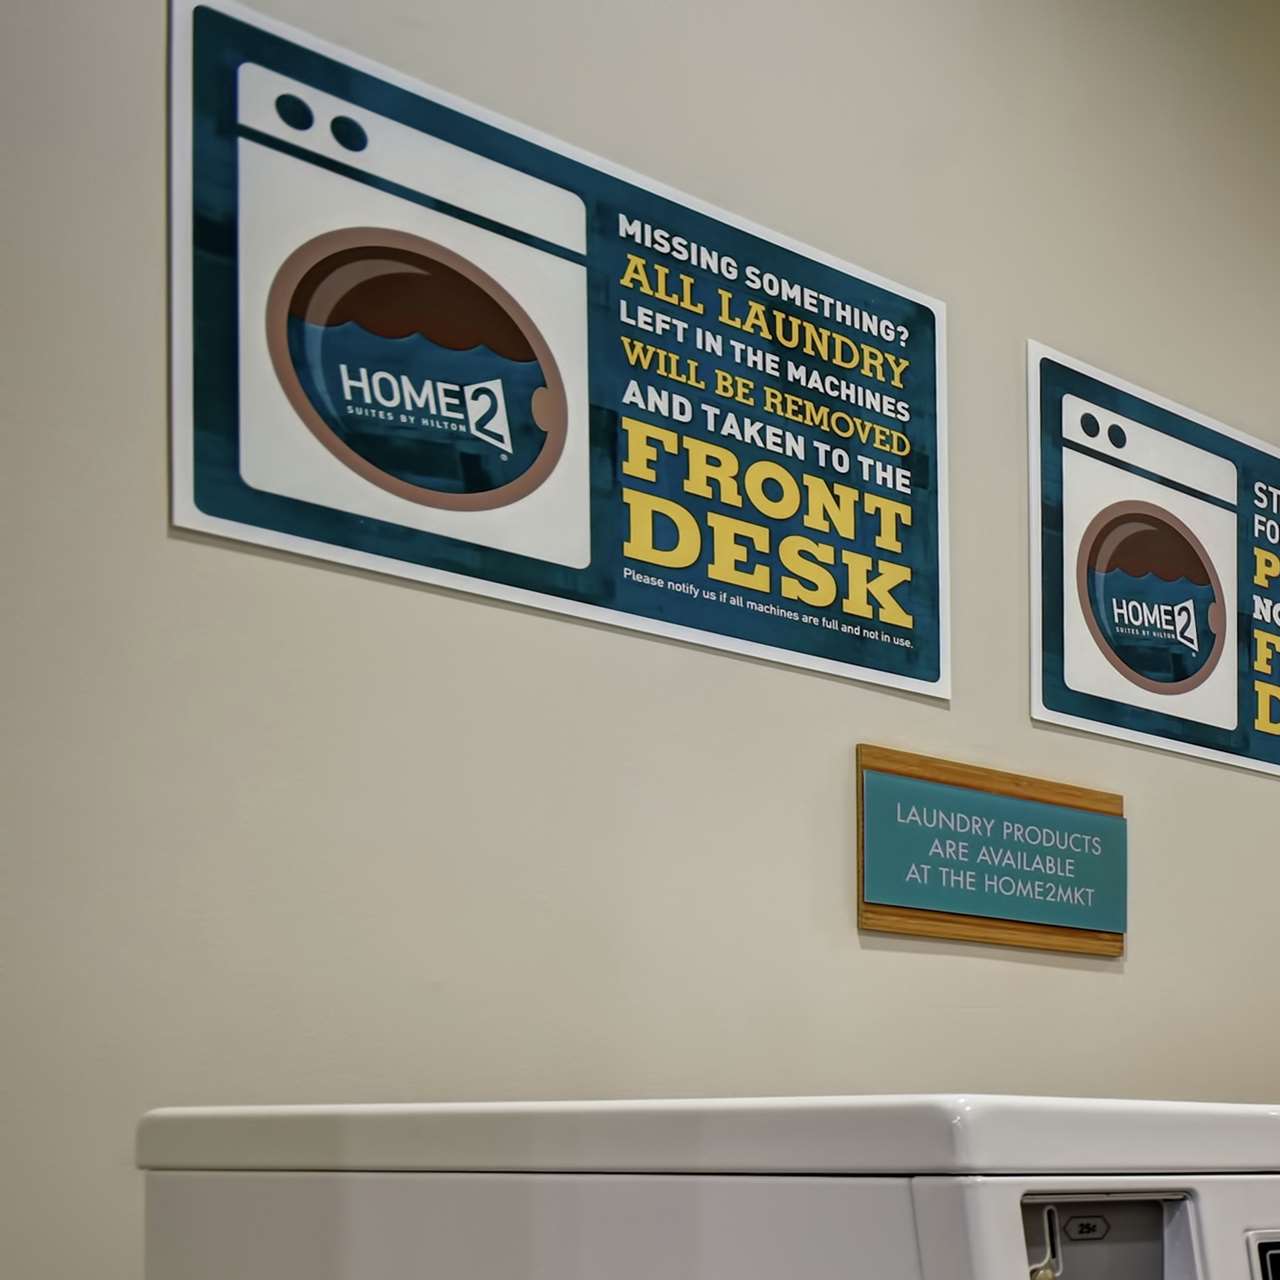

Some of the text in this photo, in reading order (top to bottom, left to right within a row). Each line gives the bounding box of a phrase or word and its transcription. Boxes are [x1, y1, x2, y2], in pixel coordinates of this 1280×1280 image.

[618, 213, 910, 347] MISSING SOMETHING?
[620, 253, 910, 388] ALL LAUNDRY
[339, 363, 513, 454] HOME2
[620, 299, 911, 422] LEFT IN THE MACHINES
[620, 336, 911, 457] WILL BE REMOVED
[346, 405, 467, 432] SUITES BY HILTON
[622, 379, 912, 495] AND TAKEN TO THE
[621, 416, 912, 554] FRONT
[622, 487, 913, 629] DESK
[623, 567, 914, 649] Please notify us if all machines are full and not in use.
[1112, 598, 1199, 652] HOME2
[896, 802, 1102, 855] LAUNDRY PRODUCTS
[928, 838, 1075, 878] ARE AVAILABLE
[905, 863, 1095, 907] AT THE HOME2MKT
